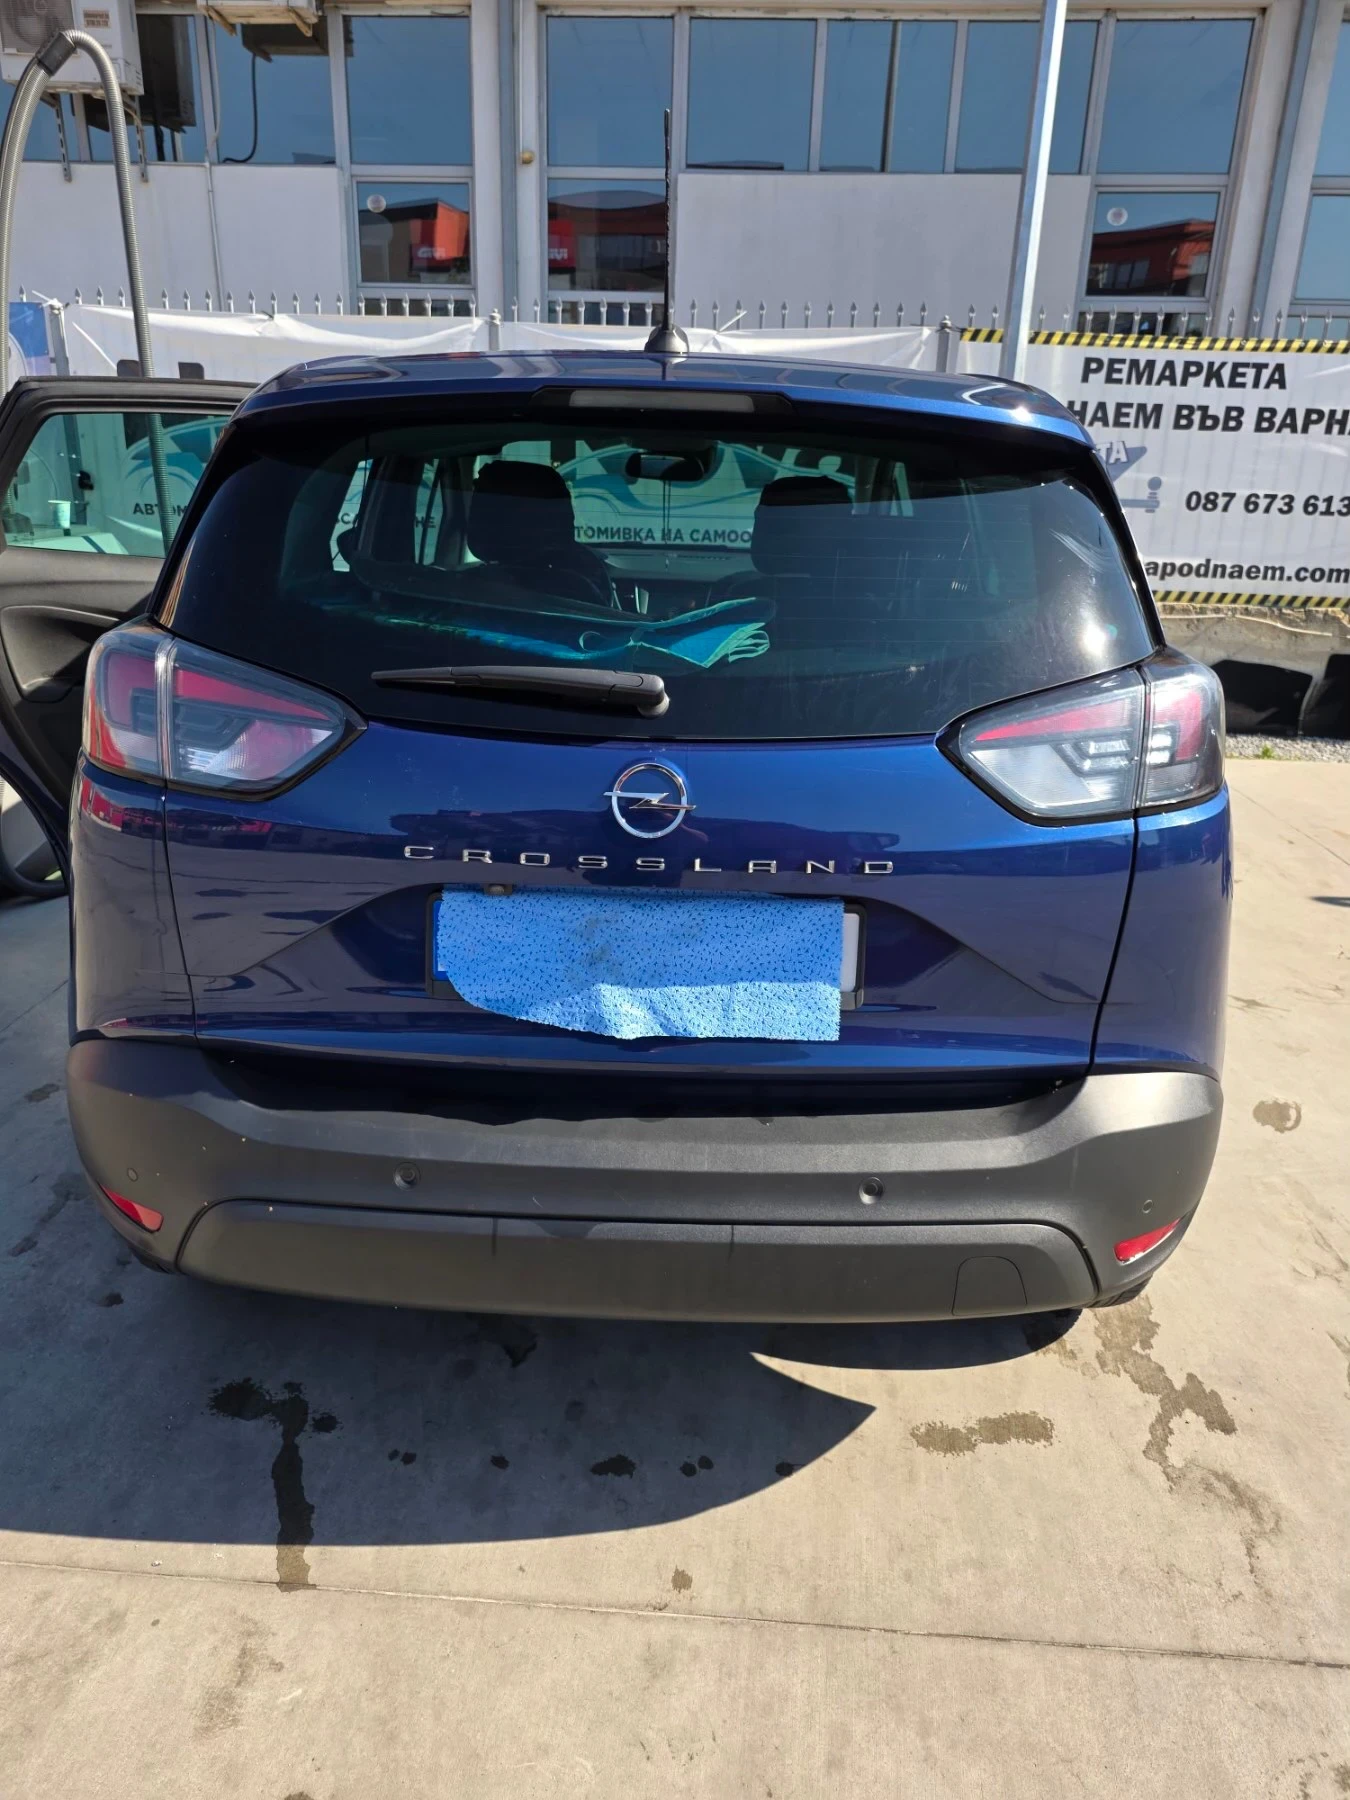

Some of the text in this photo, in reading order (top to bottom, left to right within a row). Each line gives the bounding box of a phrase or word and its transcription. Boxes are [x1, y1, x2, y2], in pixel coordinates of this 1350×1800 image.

[1080, 356, 1288, 390] РЕМАРКЕТА
[1066, 400, 1350, 436] НАЕМ ВЪВ ВАРН
[1185, 490, 1350, 517] 087 673 613
[403, 844, 895, 875] CROSSLAND
